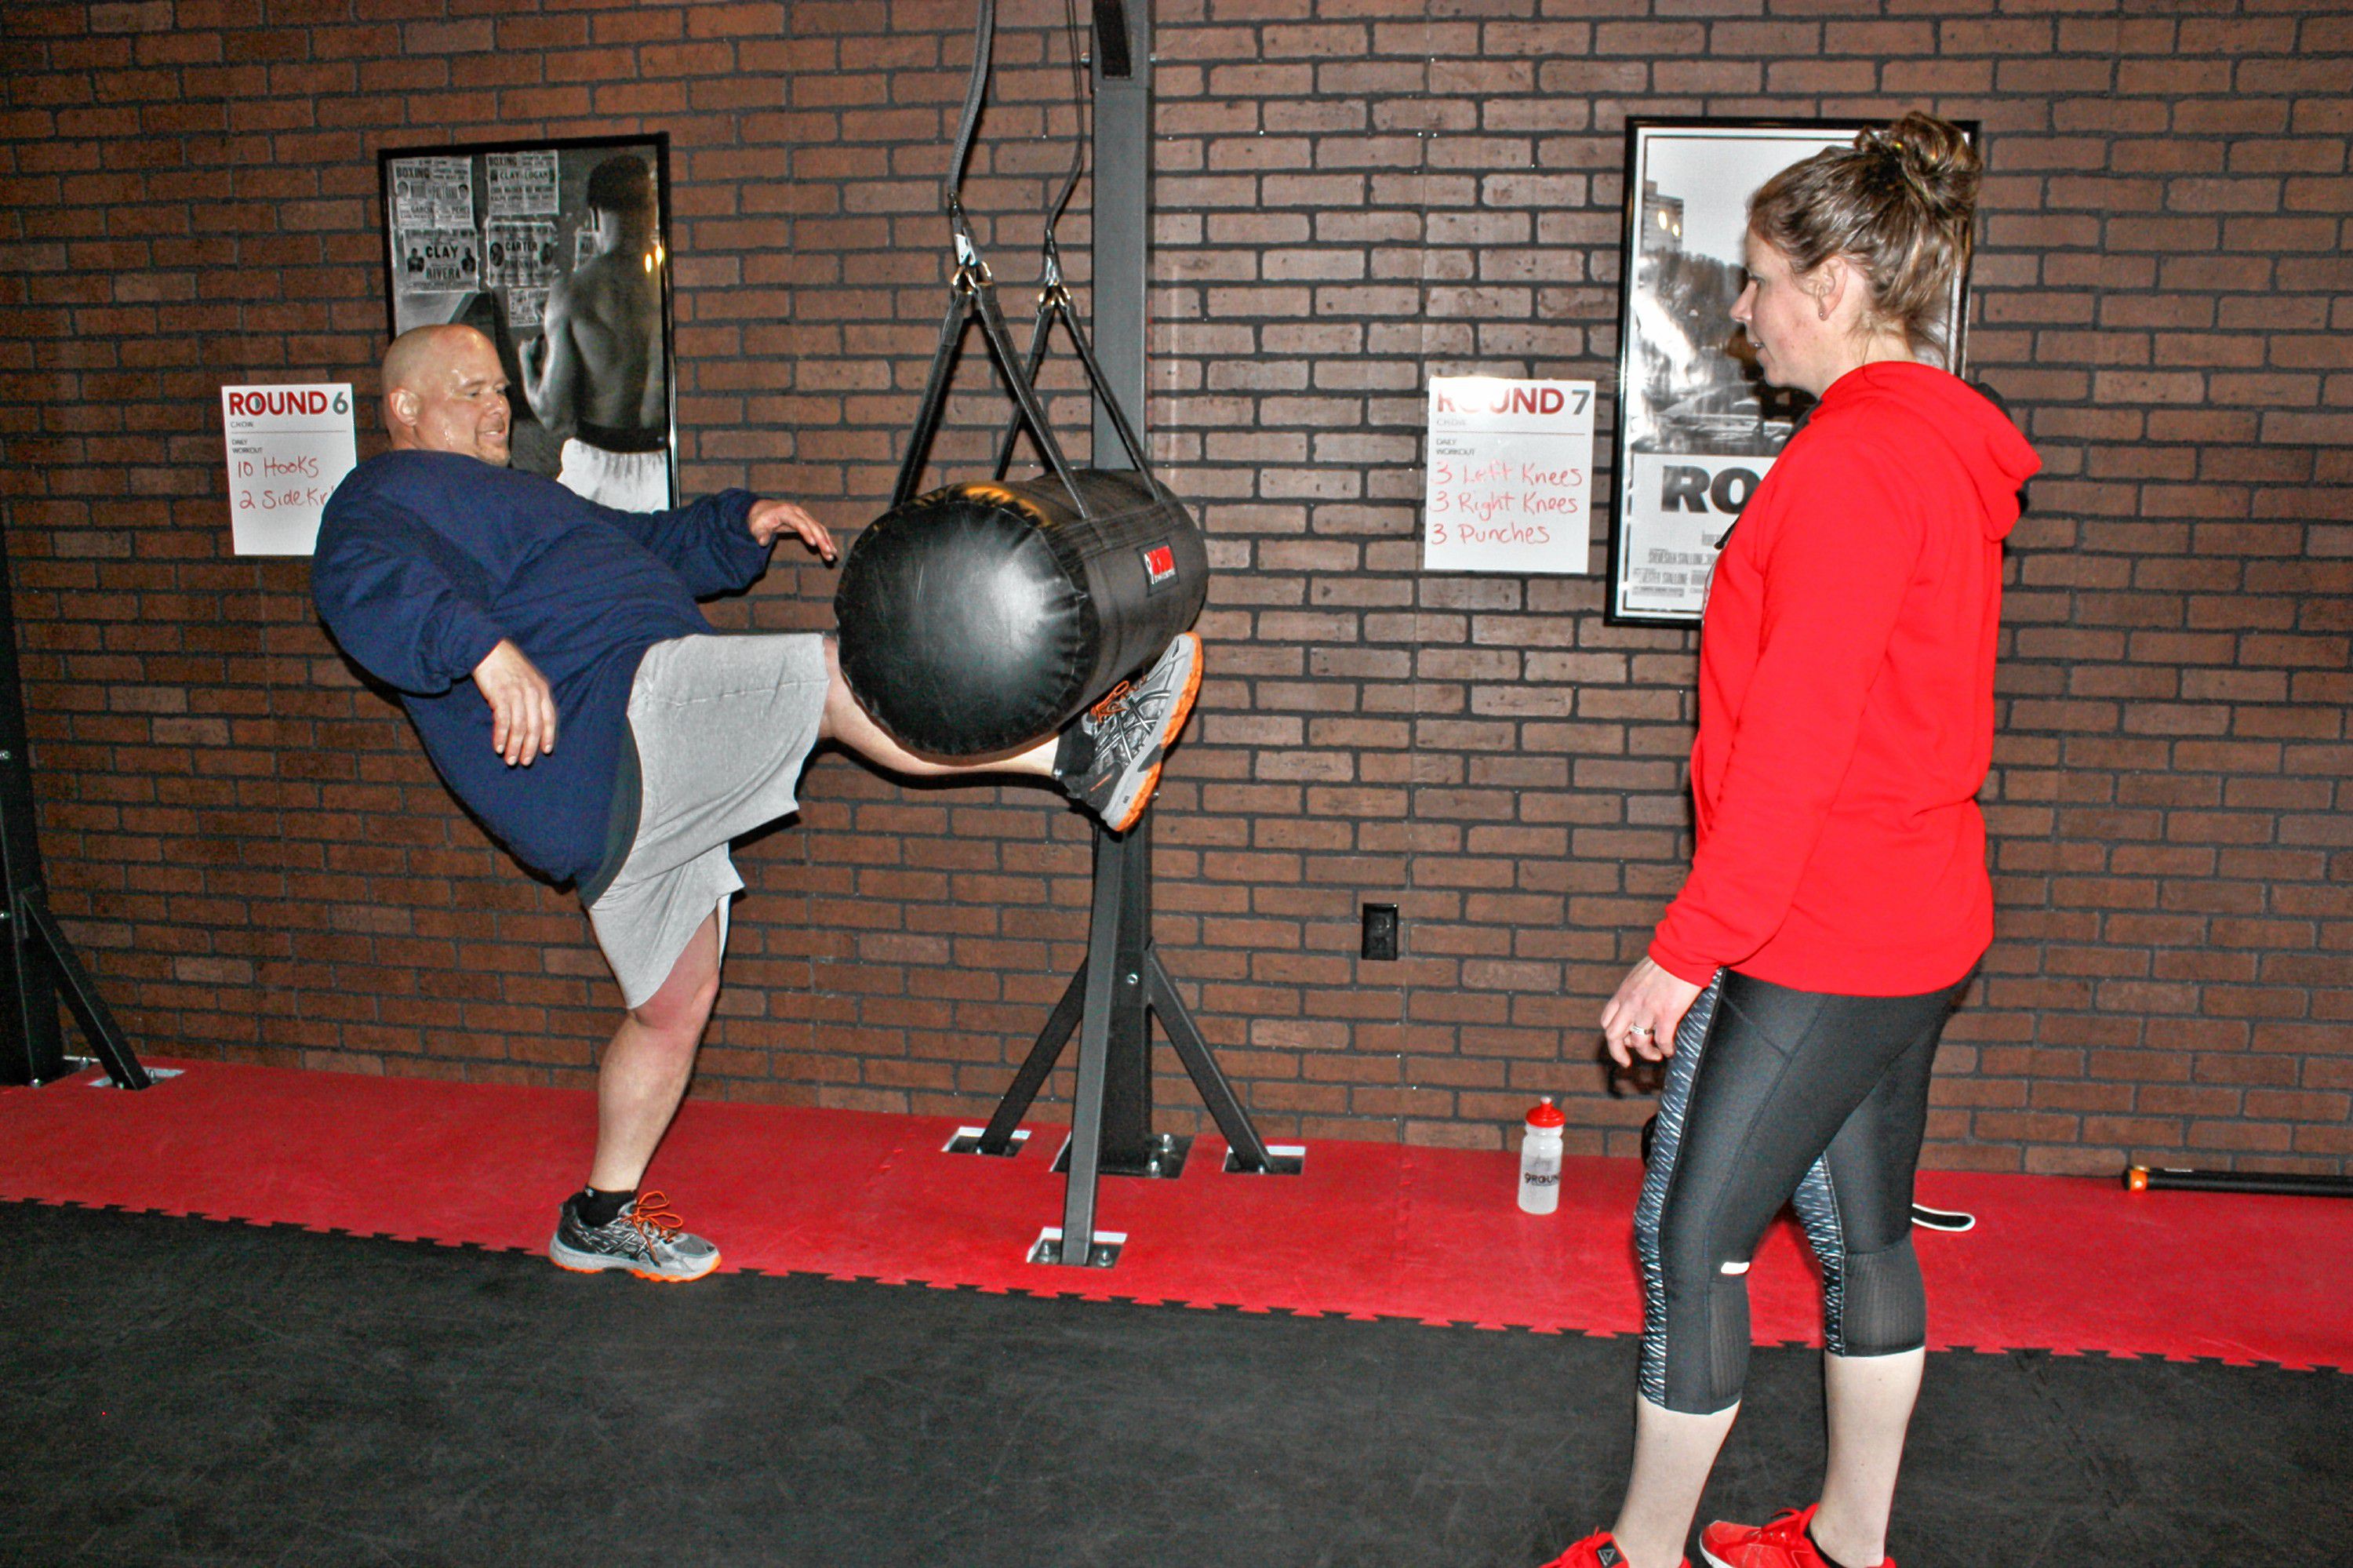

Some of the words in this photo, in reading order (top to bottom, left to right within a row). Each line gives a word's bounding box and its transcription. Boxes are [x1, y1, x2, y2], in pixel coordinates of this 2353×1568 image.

[396, 167, 431, 178] BOXING
[426, 245, 459, 258] CLAY
[505, 241, 538, 252] CARTER
[426, 267, 460, 280] RIVERA
[228, 391, 328, 417] ROUND
[333, 391, 349, 415] 6
[1571, 389, 1591, 416] 7
[238, 461, 254, 478] 10
[1430, 461, 1453, 485] 3
[1463, 460, 1512, 485] Left
[1522, 463, 1583, 486] Knees
[239, 489, 256, 510] 2
[1429, 491, 1450, 512] 3
[1457, 490, 1515, 522] Right
[1523, 491, 1579, 515] Knees
[1431, 523, 1448, 544] 3
[1457, 522, 1551, 545] Punches
